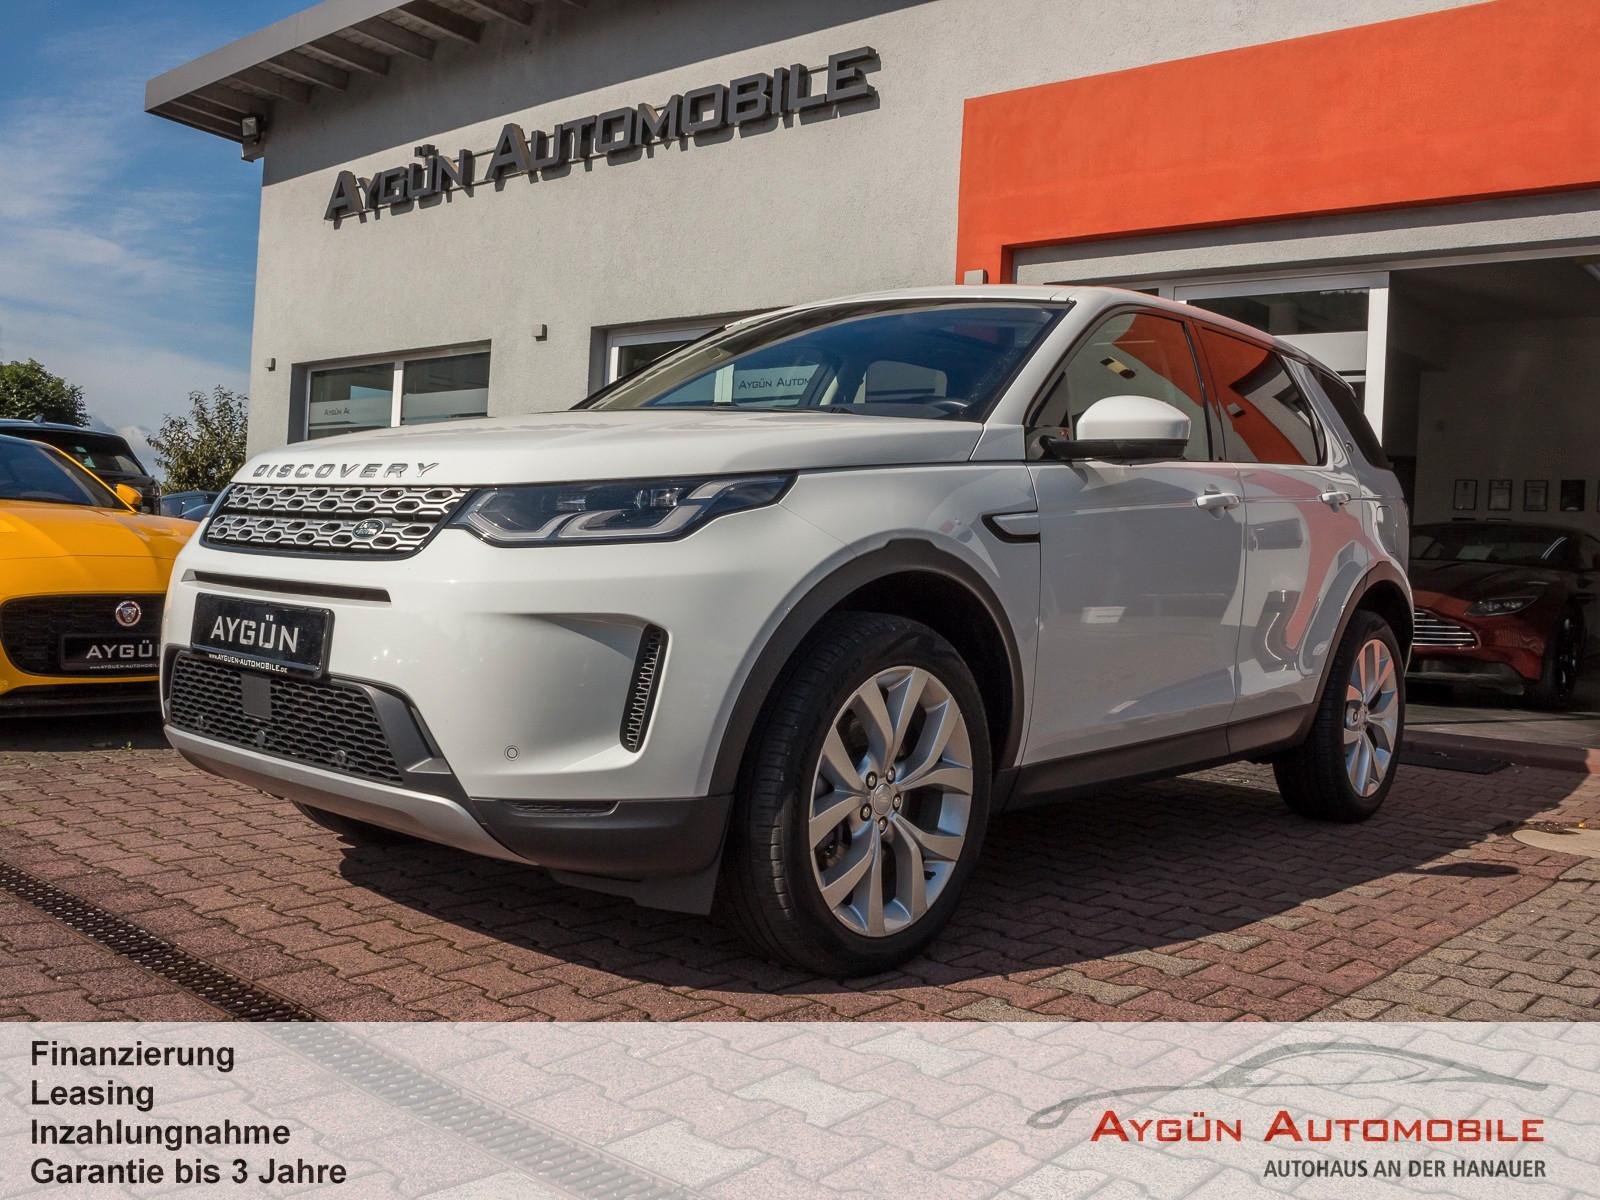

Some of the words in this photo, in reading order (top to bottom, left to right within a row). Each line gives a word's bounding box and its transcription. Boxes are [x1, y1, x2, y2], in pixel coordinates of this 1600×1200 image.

[323, 144, 474, 222] AYGÜN
[484, 45, 878, 182] AUTOMOBILE
[252, 462, 440, 478] DISCOVERY
[209, 613, 300, 654] AYGÜN
